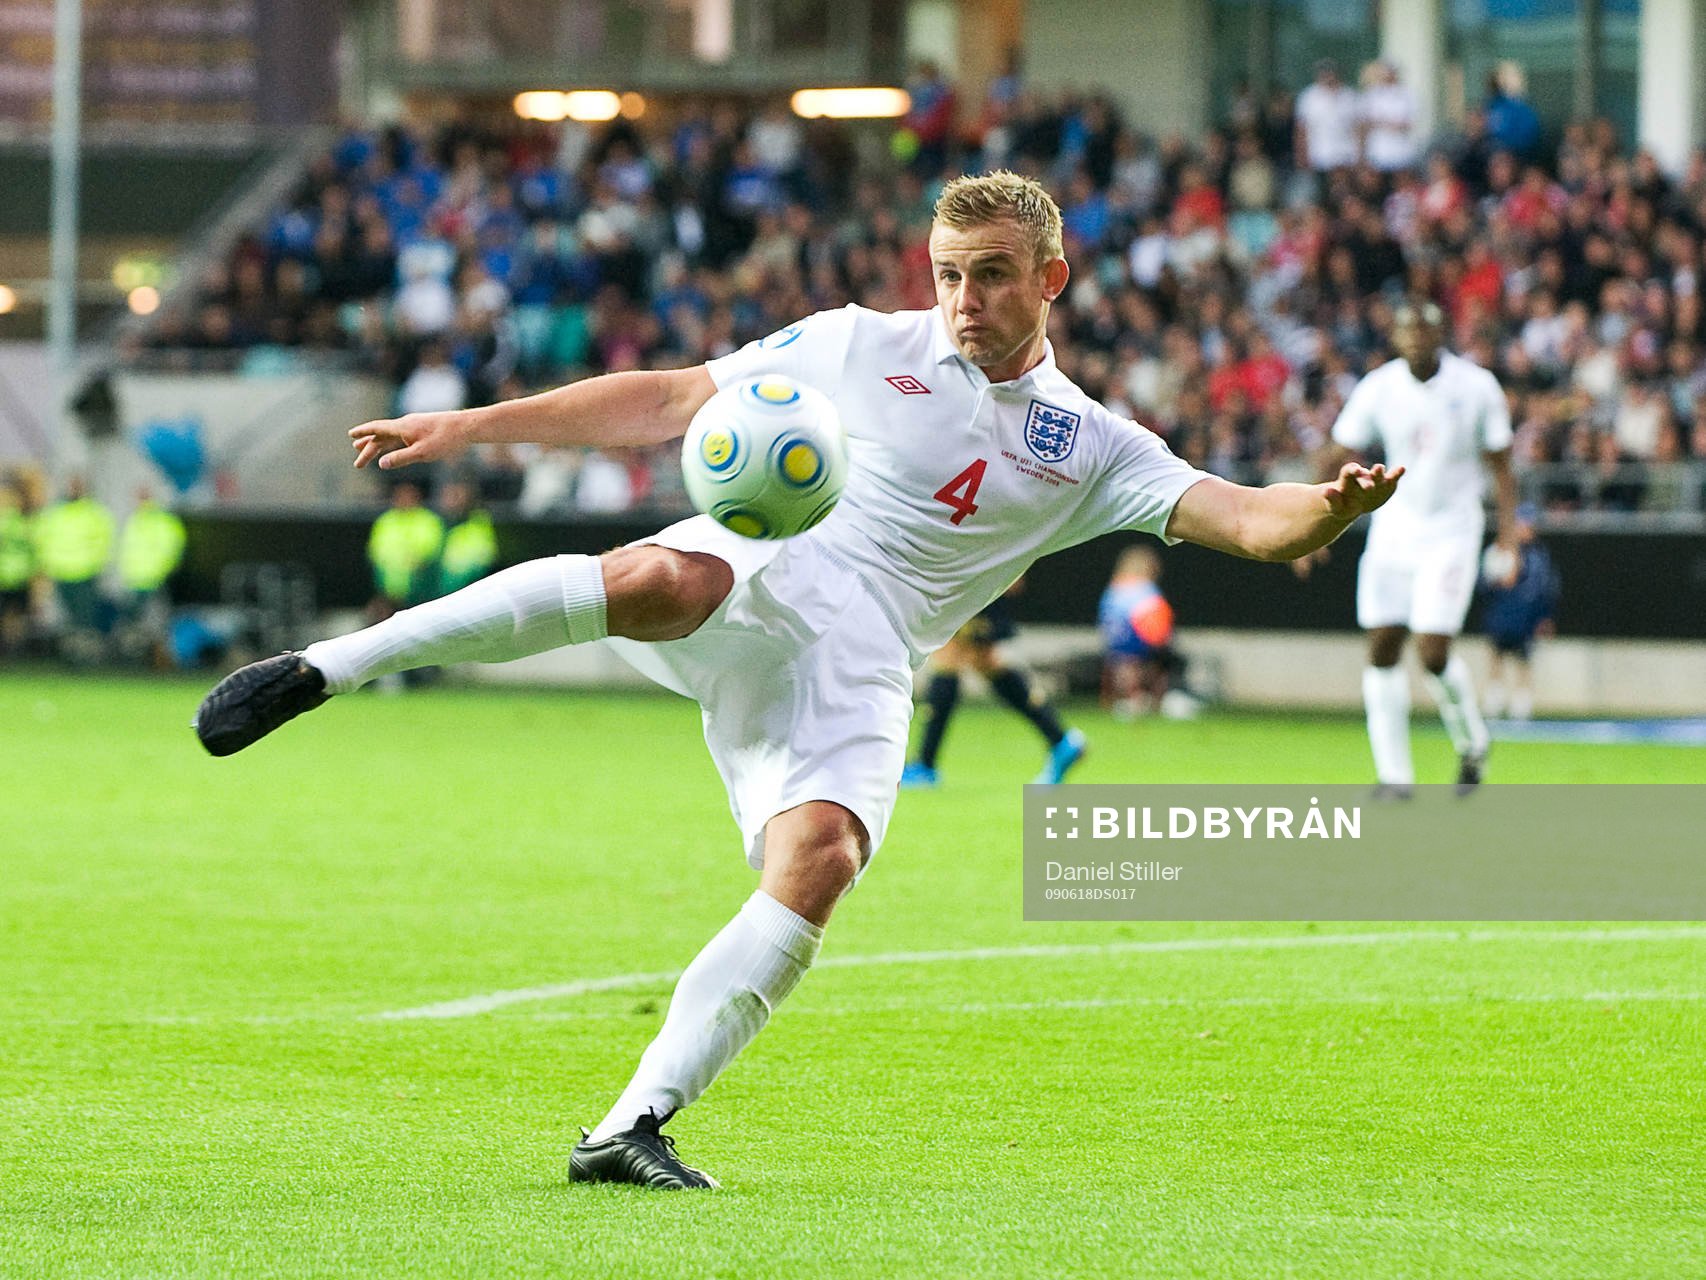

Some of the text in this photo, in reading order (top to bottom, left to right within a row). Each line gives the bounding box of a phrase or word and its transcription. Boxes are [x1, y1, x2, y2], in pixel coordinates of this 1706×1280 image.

[1001, 449, 1017, 461] UEFA
[1034, 463, 1080, 485] CHAMPIONSHIP
[1016, 465, 1044, 480] SWEDEN
[933, 458, 988, 526] 4
